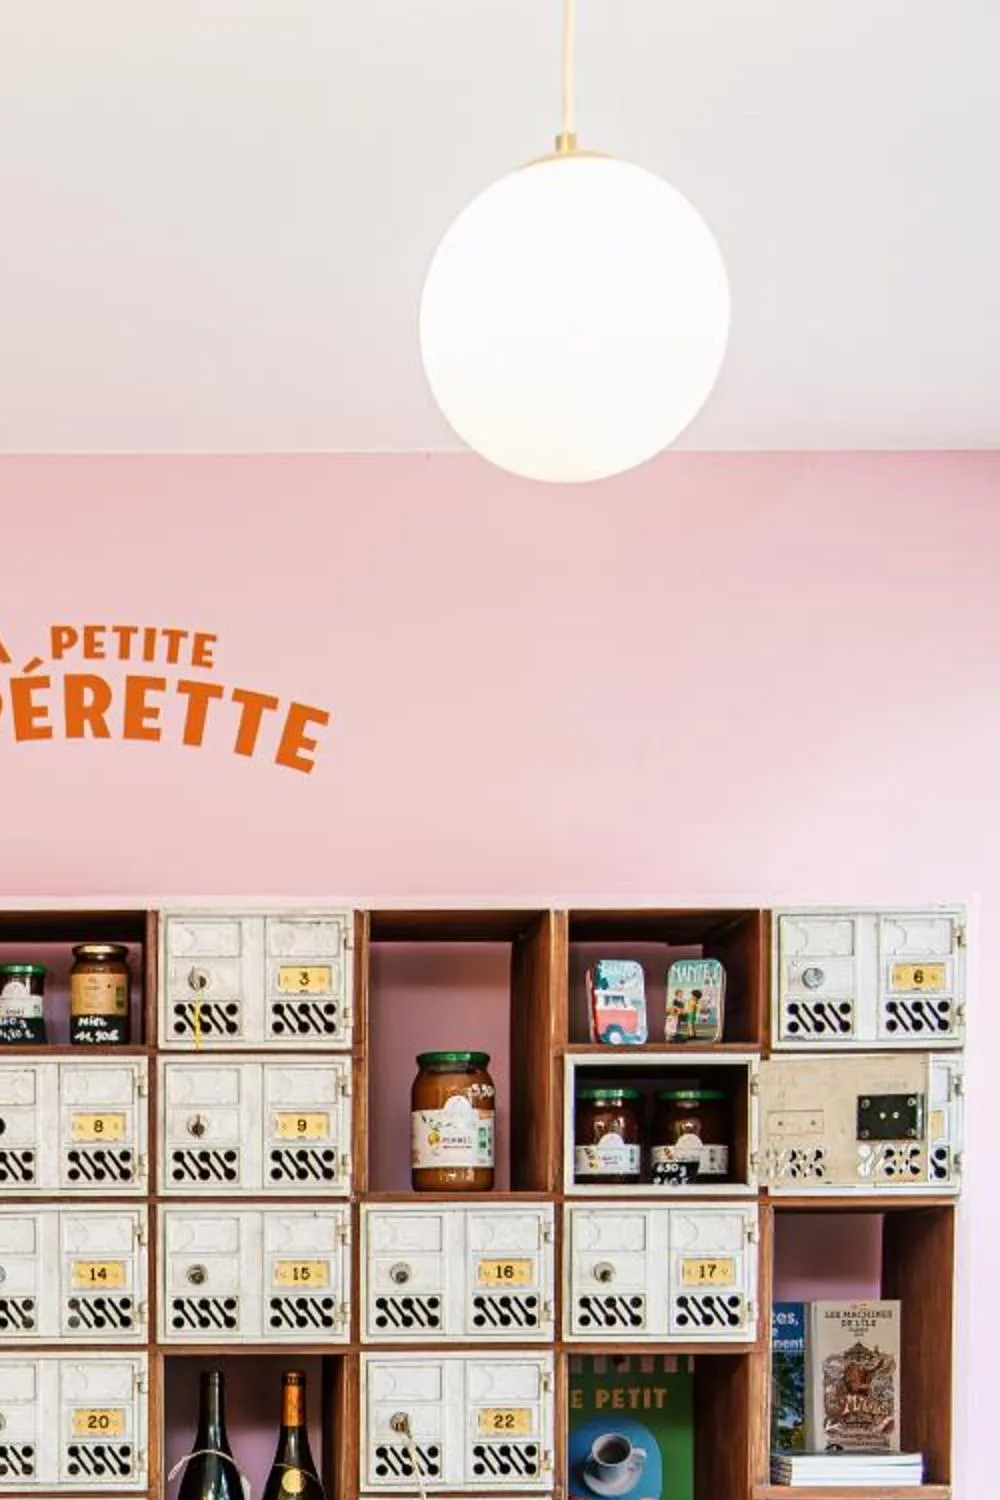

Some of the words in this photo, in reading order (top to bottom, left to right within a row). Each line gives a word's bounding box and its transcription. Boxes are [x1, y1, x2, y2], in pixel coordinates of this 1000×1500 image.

[50, 625, 218, 669] PETITE
[299, 971, 311, 987] 3
[913, 969, 925, 984] 6
[93, 1119, 104, 1134] 8
[297, 1118, 308, 1133] 9
[90, 1267, 108, 1281] 14
[293, 1266, 311, 1281] 15
[496, 1265, 515, 1279] 16
[699, 1263, 717, 1279] 17
[595, 1388, 667, 1409] PETIT
[87, 1414, 110, 1429] 20
[493, 1413, 515, 1429] 22
